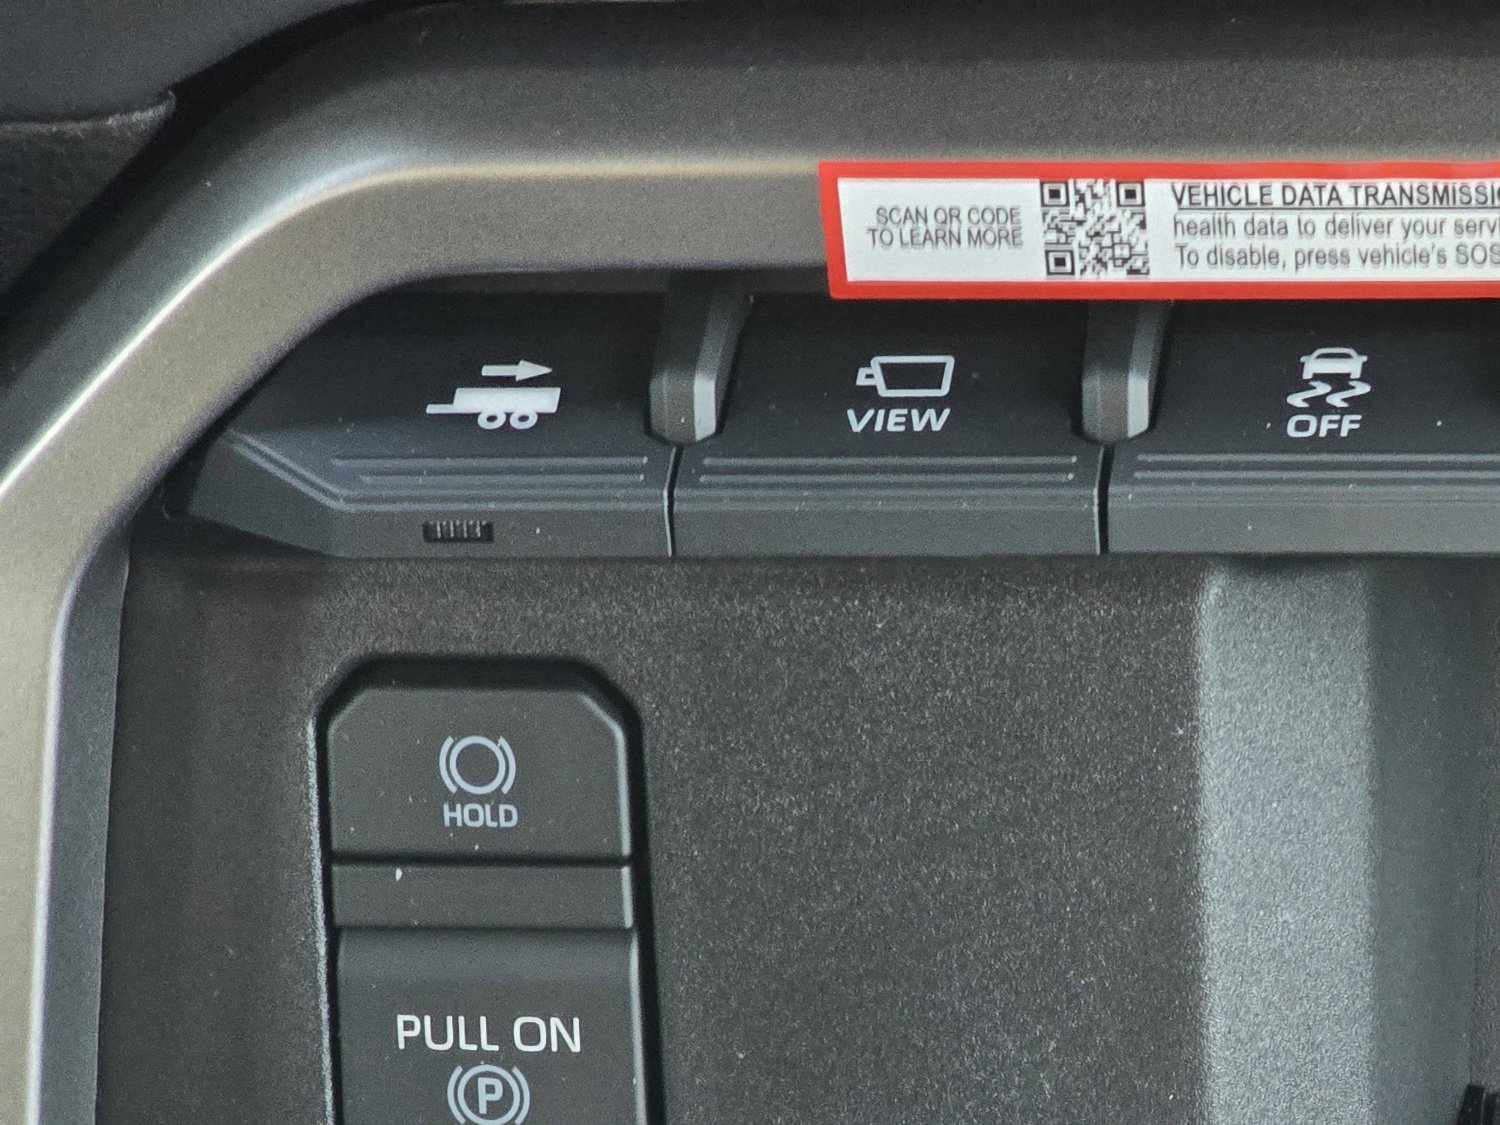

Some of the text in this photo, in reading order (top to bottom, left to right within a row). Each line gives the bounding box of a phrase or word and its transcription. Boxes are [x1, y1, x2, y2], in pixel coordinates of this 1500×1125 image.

[1172, 184, 1273, 207] VEHICLE
[1282, 184, 1343, 206] DATA
[876, 206, 1022, 226] SCAN QR CODE
[1173, 212, 1236, 237] health
[1244, 212, 1288, 237] data
[1297, 213, 1316, 237] to
[1325, 212, 1393, 237] deliver
[1401, 217, 1447, 241] your
[868, 228, 1023, 247] TO LEARN MORE
[1176, 243, 1199, 266] To
[1207, 242, 1286, 269] disable,
[1295, 247, 1350, 271] press
[1358, 242, 1447, 266] vehicle's
[846, 408, 951, 432] VIEW
[1286, 414, 1363, 438] OFF
[443, 804, 518, 828] HOLD
[396, 1014, 581, 1053] PULL ON
[477, 1076, 503, 1114] P
